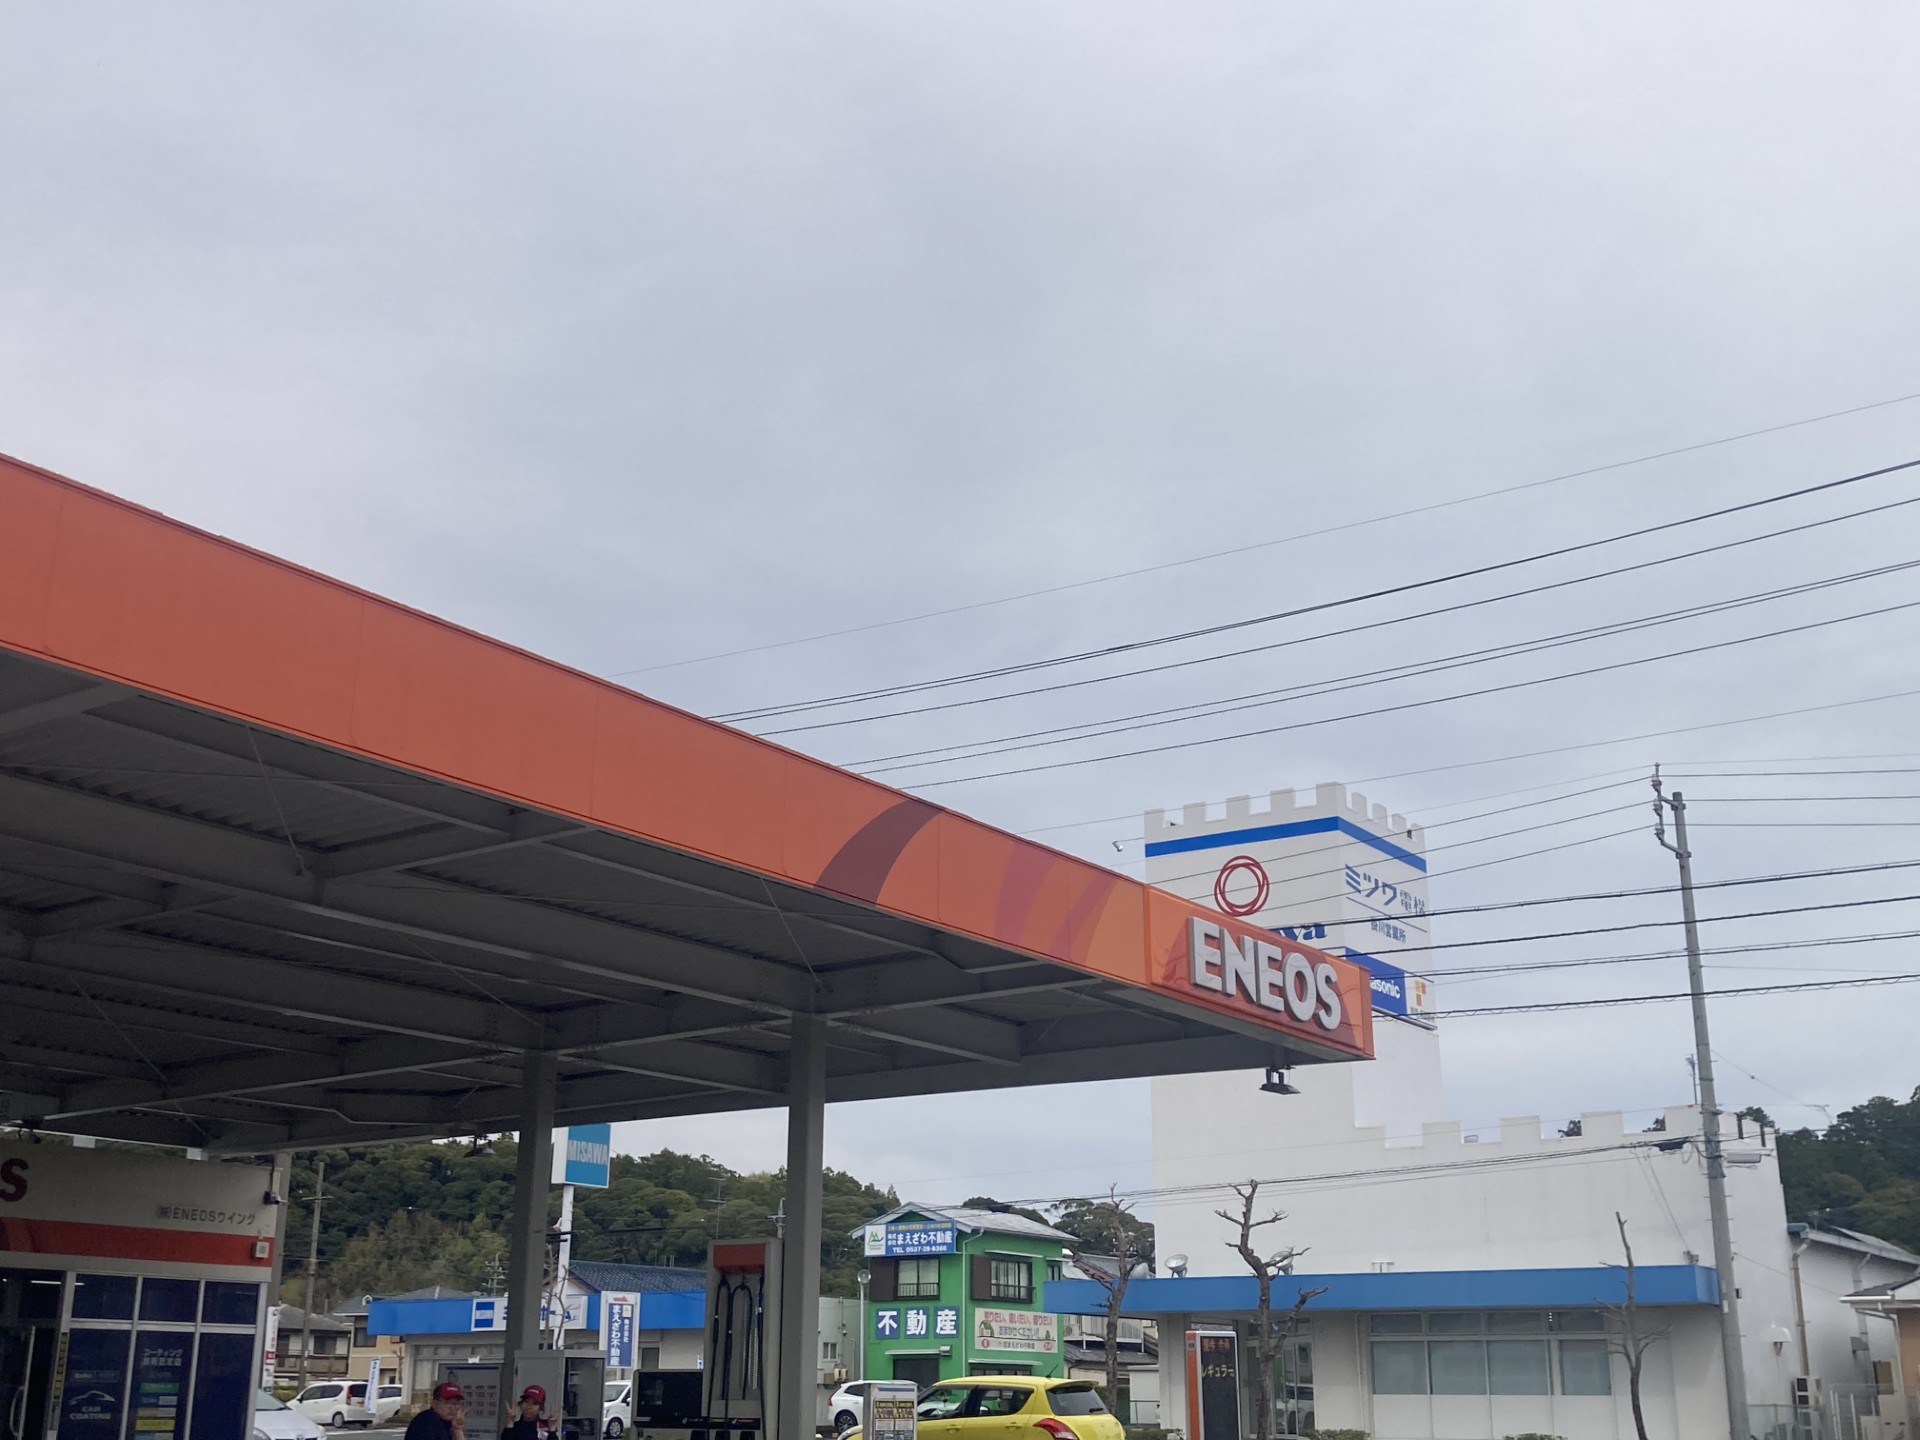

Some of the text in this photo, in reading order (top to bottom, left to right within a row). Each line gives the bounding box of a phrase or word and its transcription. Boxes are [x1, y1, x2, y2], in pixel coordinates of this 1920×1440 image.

[1189, 916, 1341, 1031] ENEOS
[567, 1140, 608, 1165] MISAWA
[0, 1158, 29, 1202] S
[897, 1231, 953, 1245] まえざわ不動産
[877, 1309, 957, 1335] 不動産
[610, 1305, 621, 1366] まえざわ不動産
[1201, 1363, 1234, 1377] レギュラー
